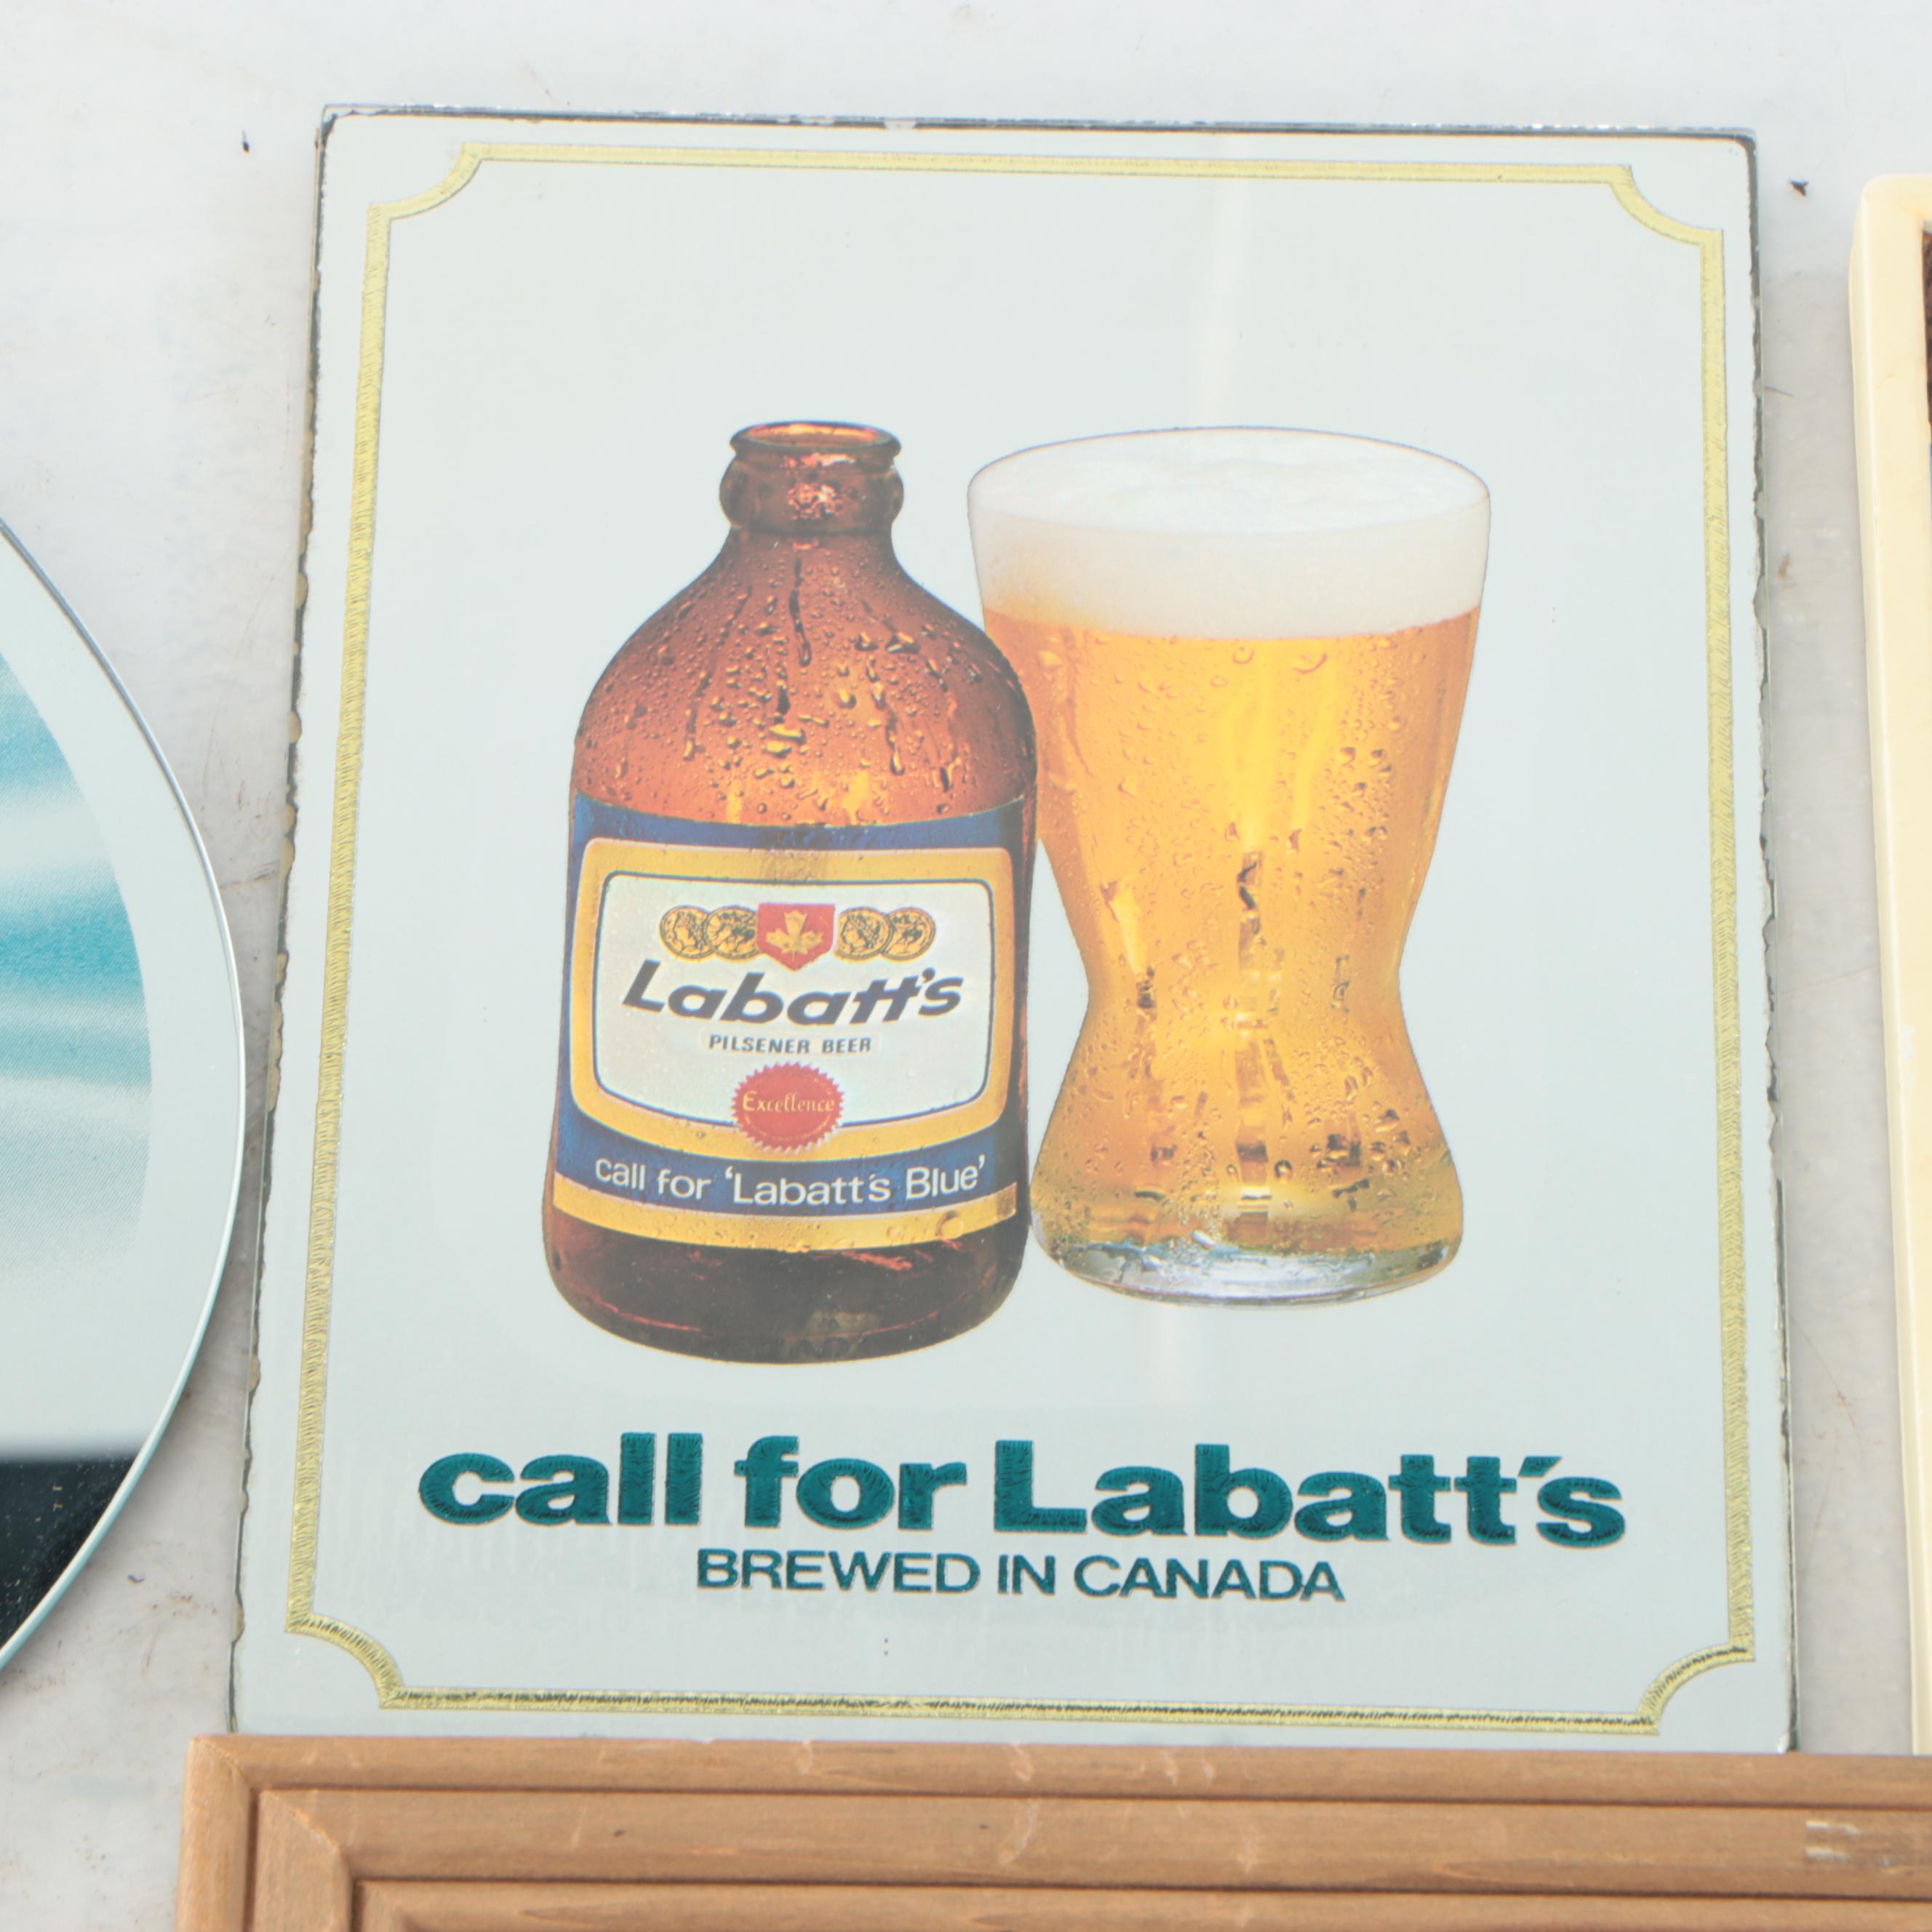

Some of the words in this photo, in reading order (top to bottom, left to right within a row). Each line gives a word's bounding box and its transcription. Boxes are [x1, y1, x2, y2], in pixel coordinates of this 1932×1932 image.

[622, 958, 964, 1025] Labatt's
[708, 1034, 810, 1055] PILSENER
[821, 1037, 871, 1054] BEER
[742, 1090, 835, 1113] Excellence
[595, 1158, 645, 1191] call
[657, 1169, 711, 1199] for
[418, 1432, 703, 1527] call
[734, 1434, 967, 1530] for
[993, 1439, 1626, 1549] Labatt's
[697, 1548, 981, 1594] BREWED
[997, 1554, 1055, 1595] IN
[1074, 1555, 1346, 1602] CANADA
